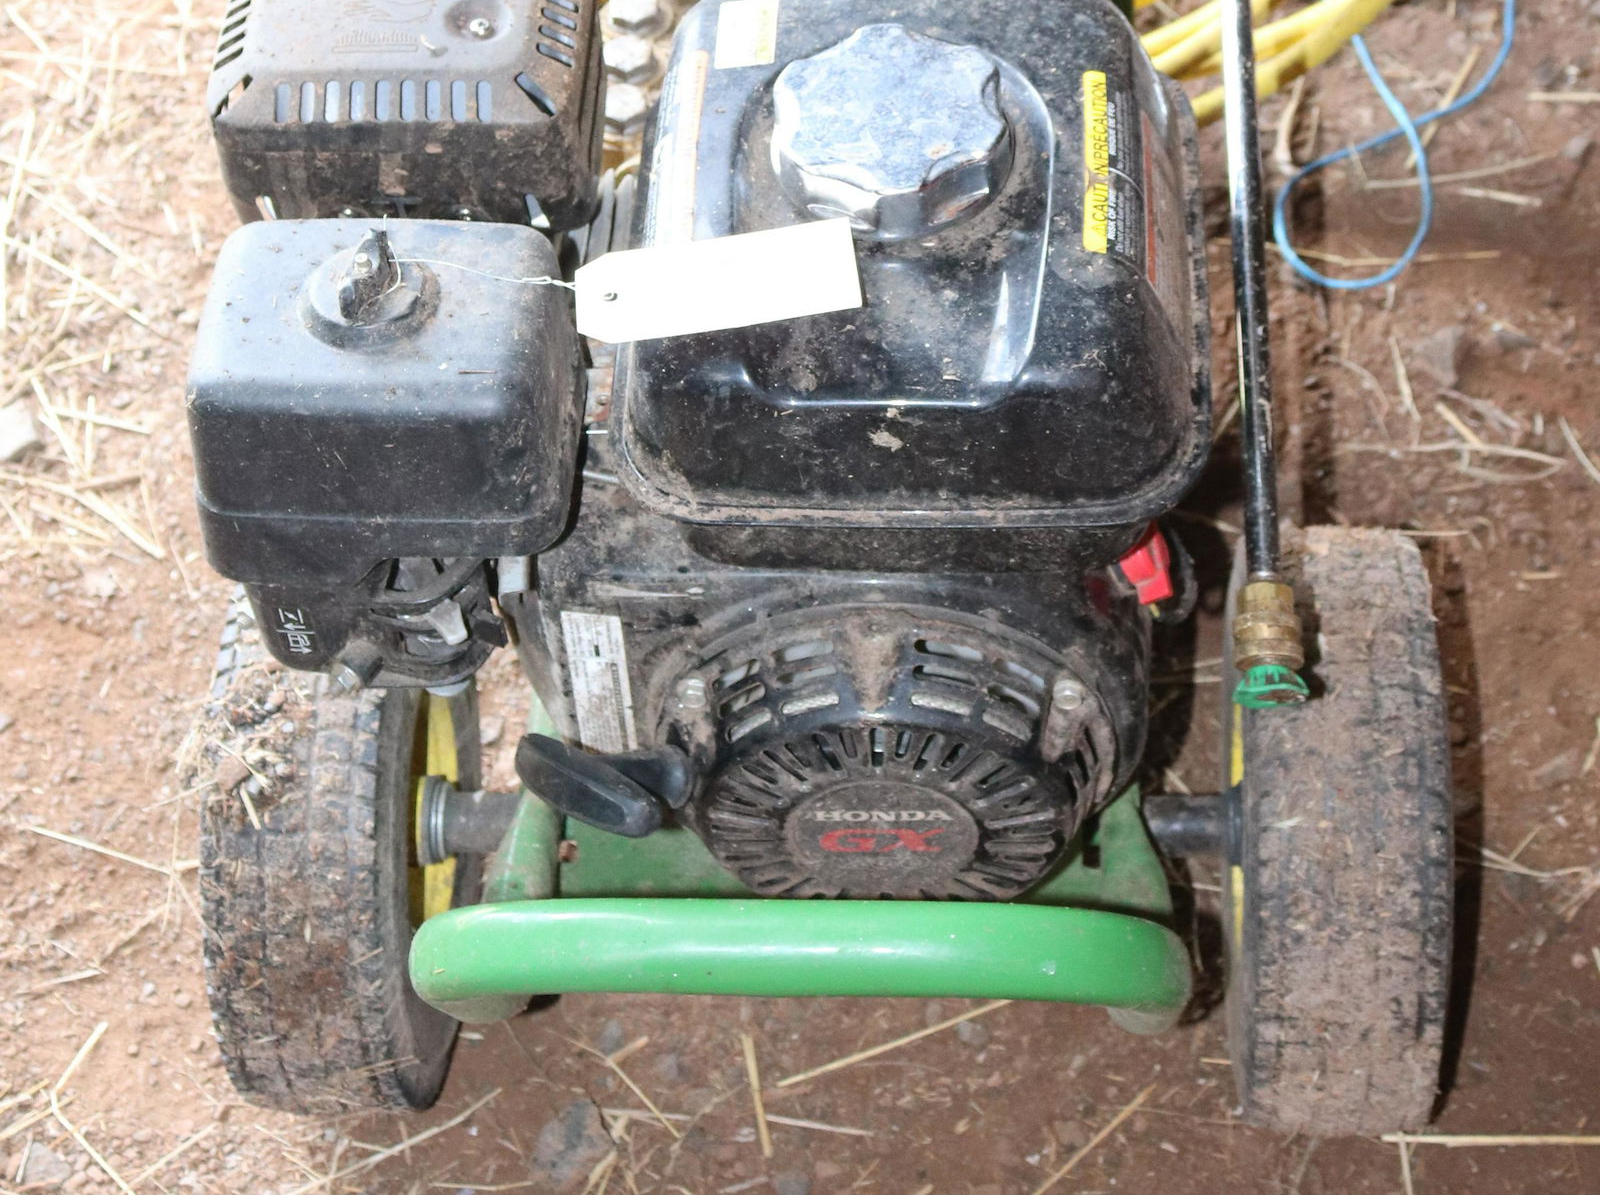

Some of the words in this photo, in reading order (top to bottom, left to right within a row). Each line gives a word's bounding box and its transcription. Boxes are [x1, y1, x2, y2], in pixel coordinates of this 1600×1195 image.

[1107, 219, 1117, 240] RISK
[814, 809, 954, 822] HONDA
[818, 827, 945, 853] GX
